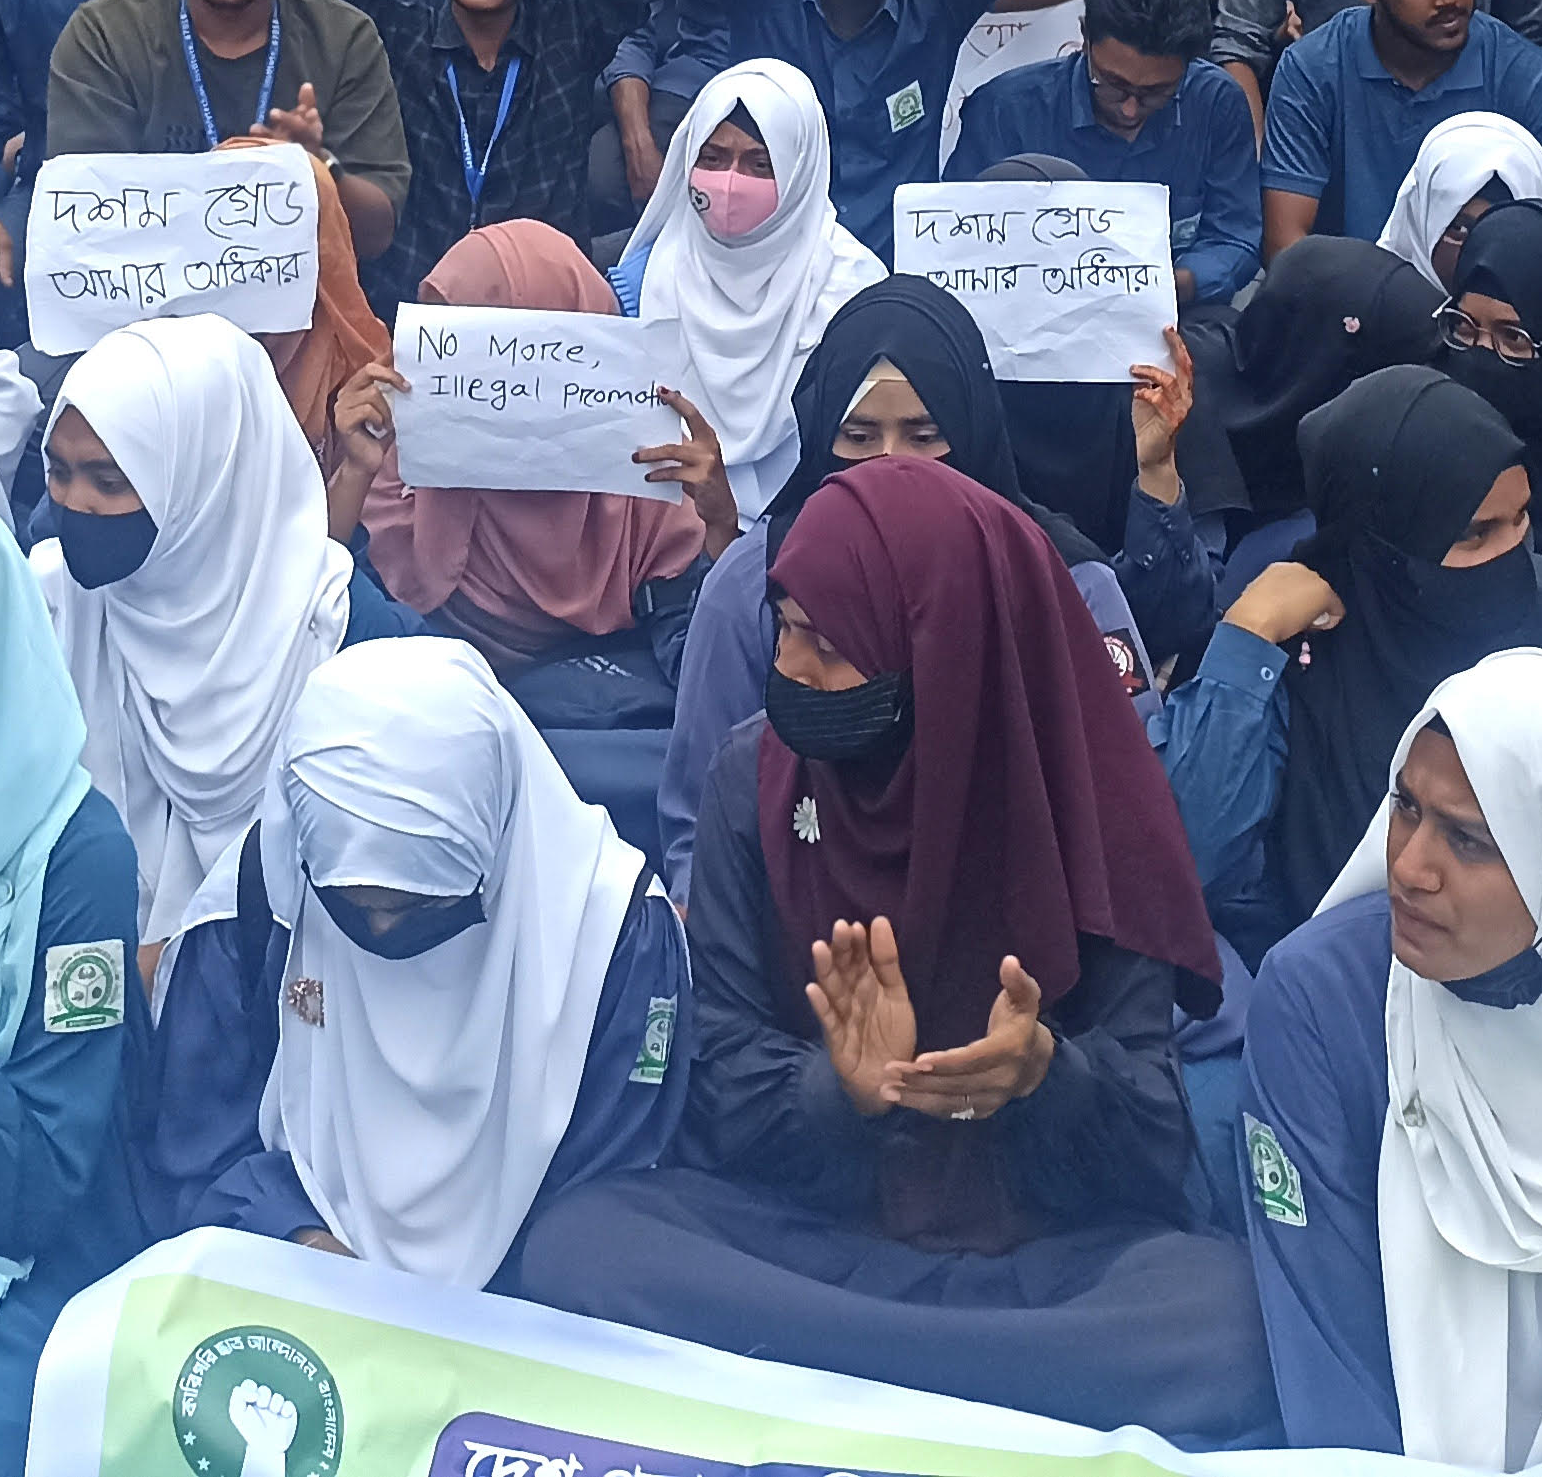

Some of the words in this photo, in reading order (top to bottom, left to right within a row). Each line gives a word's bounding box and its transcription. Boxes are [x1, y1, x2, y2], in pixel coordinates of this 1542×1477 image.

[45, 187, 181, 234] দশম
[906, 208, 1027, 246] দশম
[47, 261, 168, 311] আমার
[183, 244, 311, 288] অধিকার
[429, 374, 541, 411] Illegal
